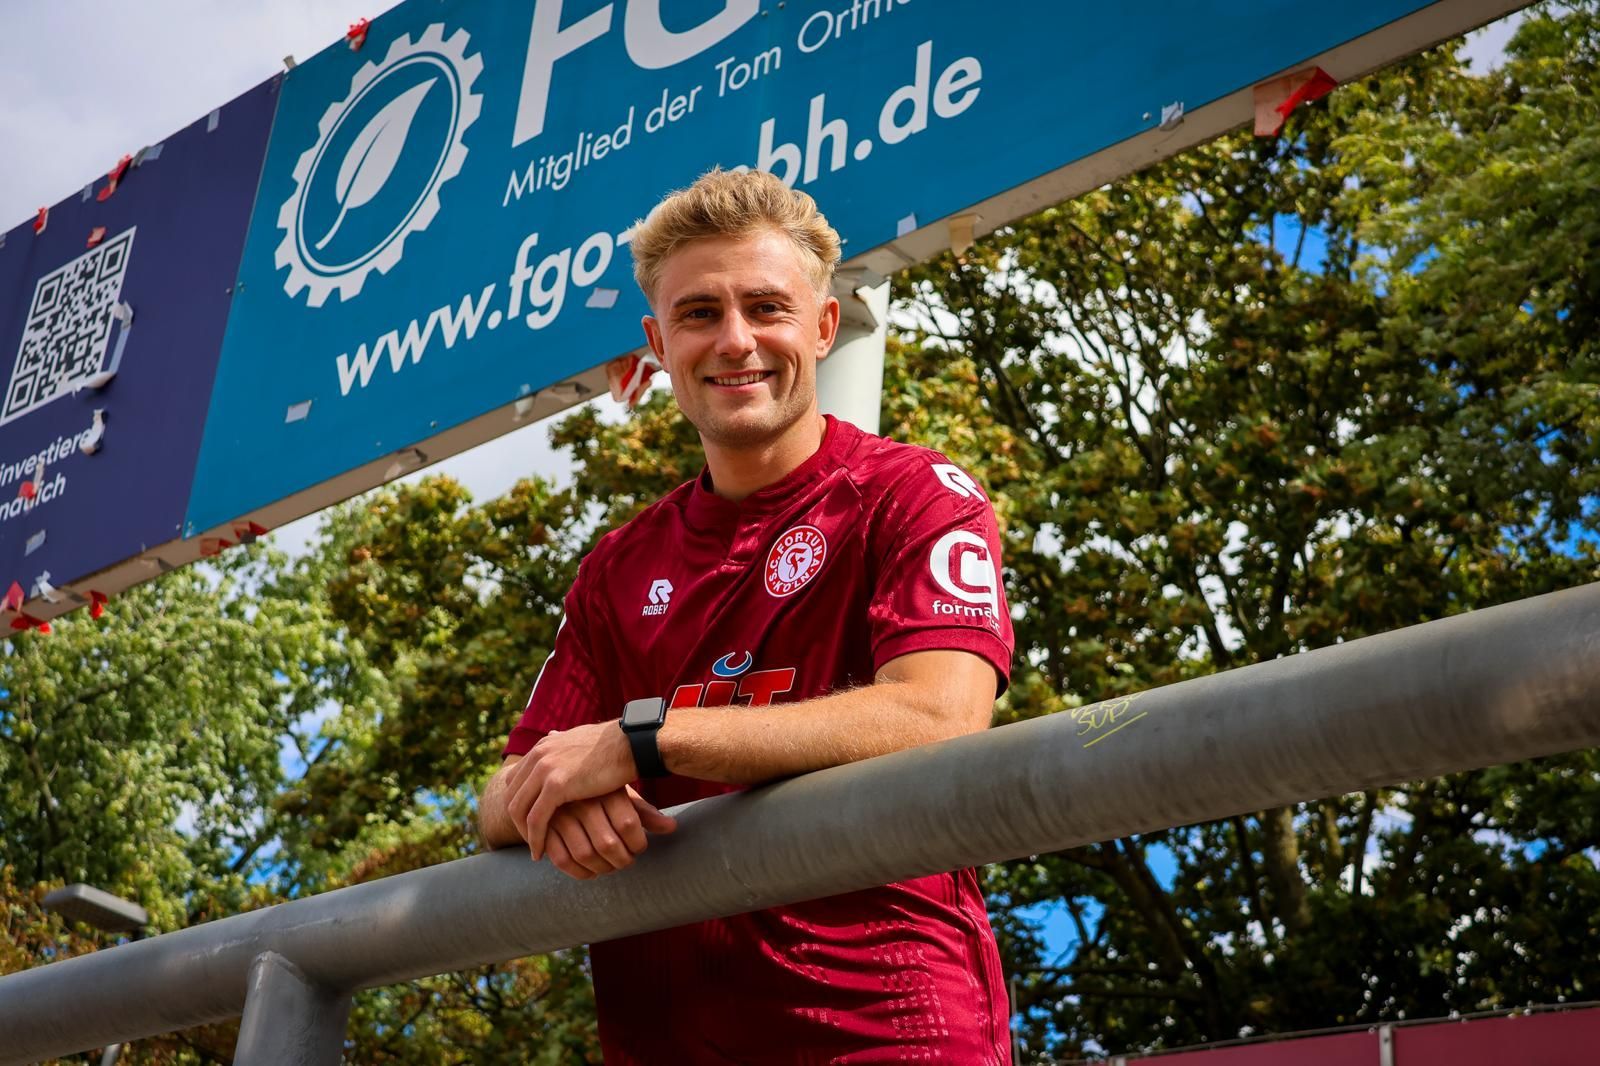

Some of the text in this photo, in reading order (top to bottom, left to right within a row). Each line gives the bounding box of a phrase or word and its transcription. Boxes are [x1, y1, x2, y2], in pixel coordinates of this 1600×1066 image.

[502, 0, 910, 207] Mitglied der Tom Ortm
[335, 40, 983, 397] www.fgo-bh.de
[0, 428, 97, 487] investiere
[776, 531, 823, 568] FORTUNA
[641, 603, 669, 617] ROBEY
